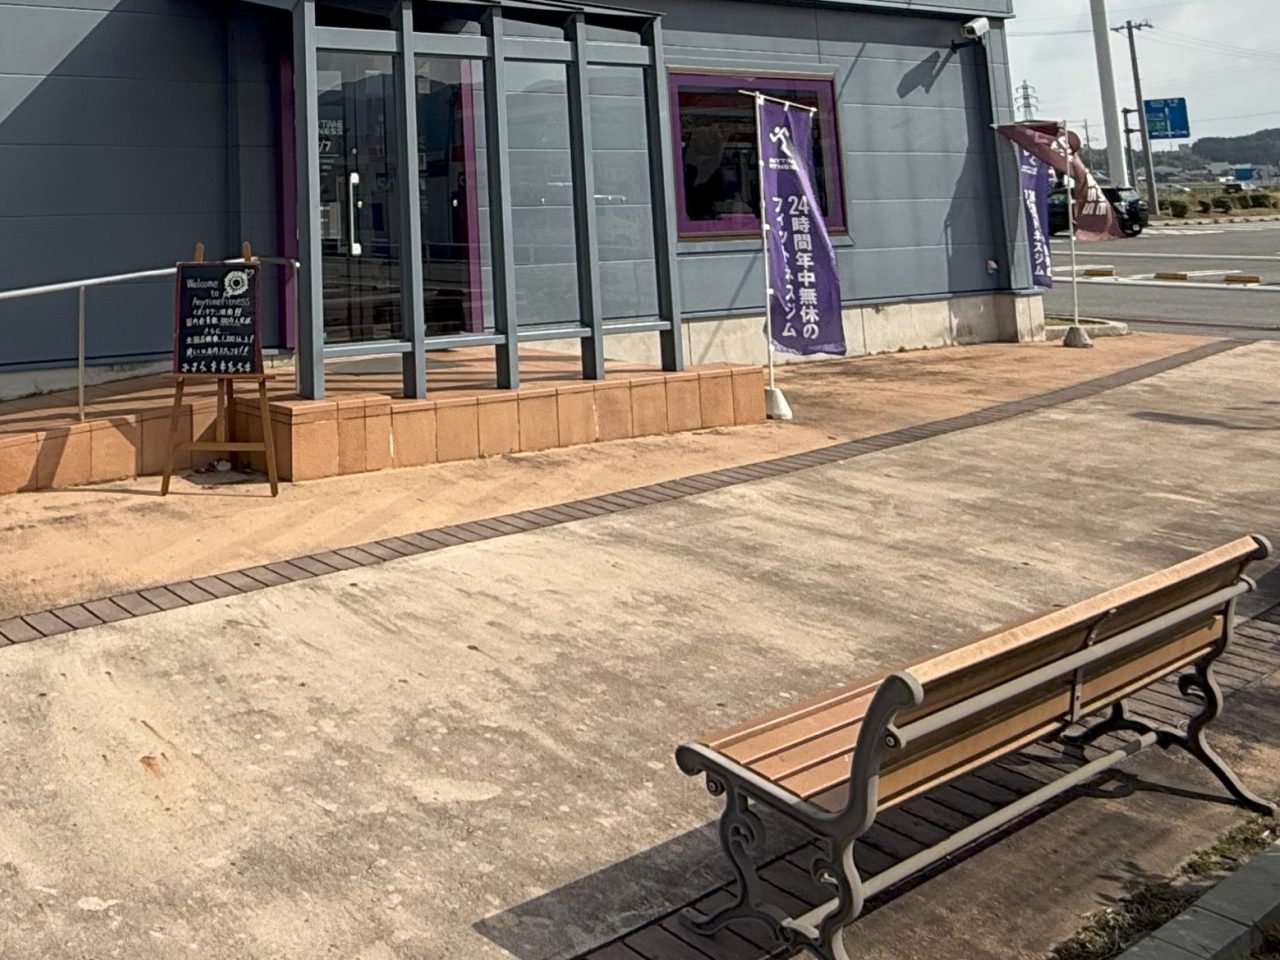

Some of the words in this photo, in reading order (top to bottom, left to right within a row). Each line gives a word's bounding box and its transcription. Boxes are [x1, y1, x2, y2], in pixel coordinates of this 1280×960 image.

[319, 120, 344, 129] TIME
[319, 128, 344, 136] NESS
[788, 195, 820, 339] 24時間年中無休の
[186, 279, 219, 289] Welcome
[210, 289, 220, 298] to
